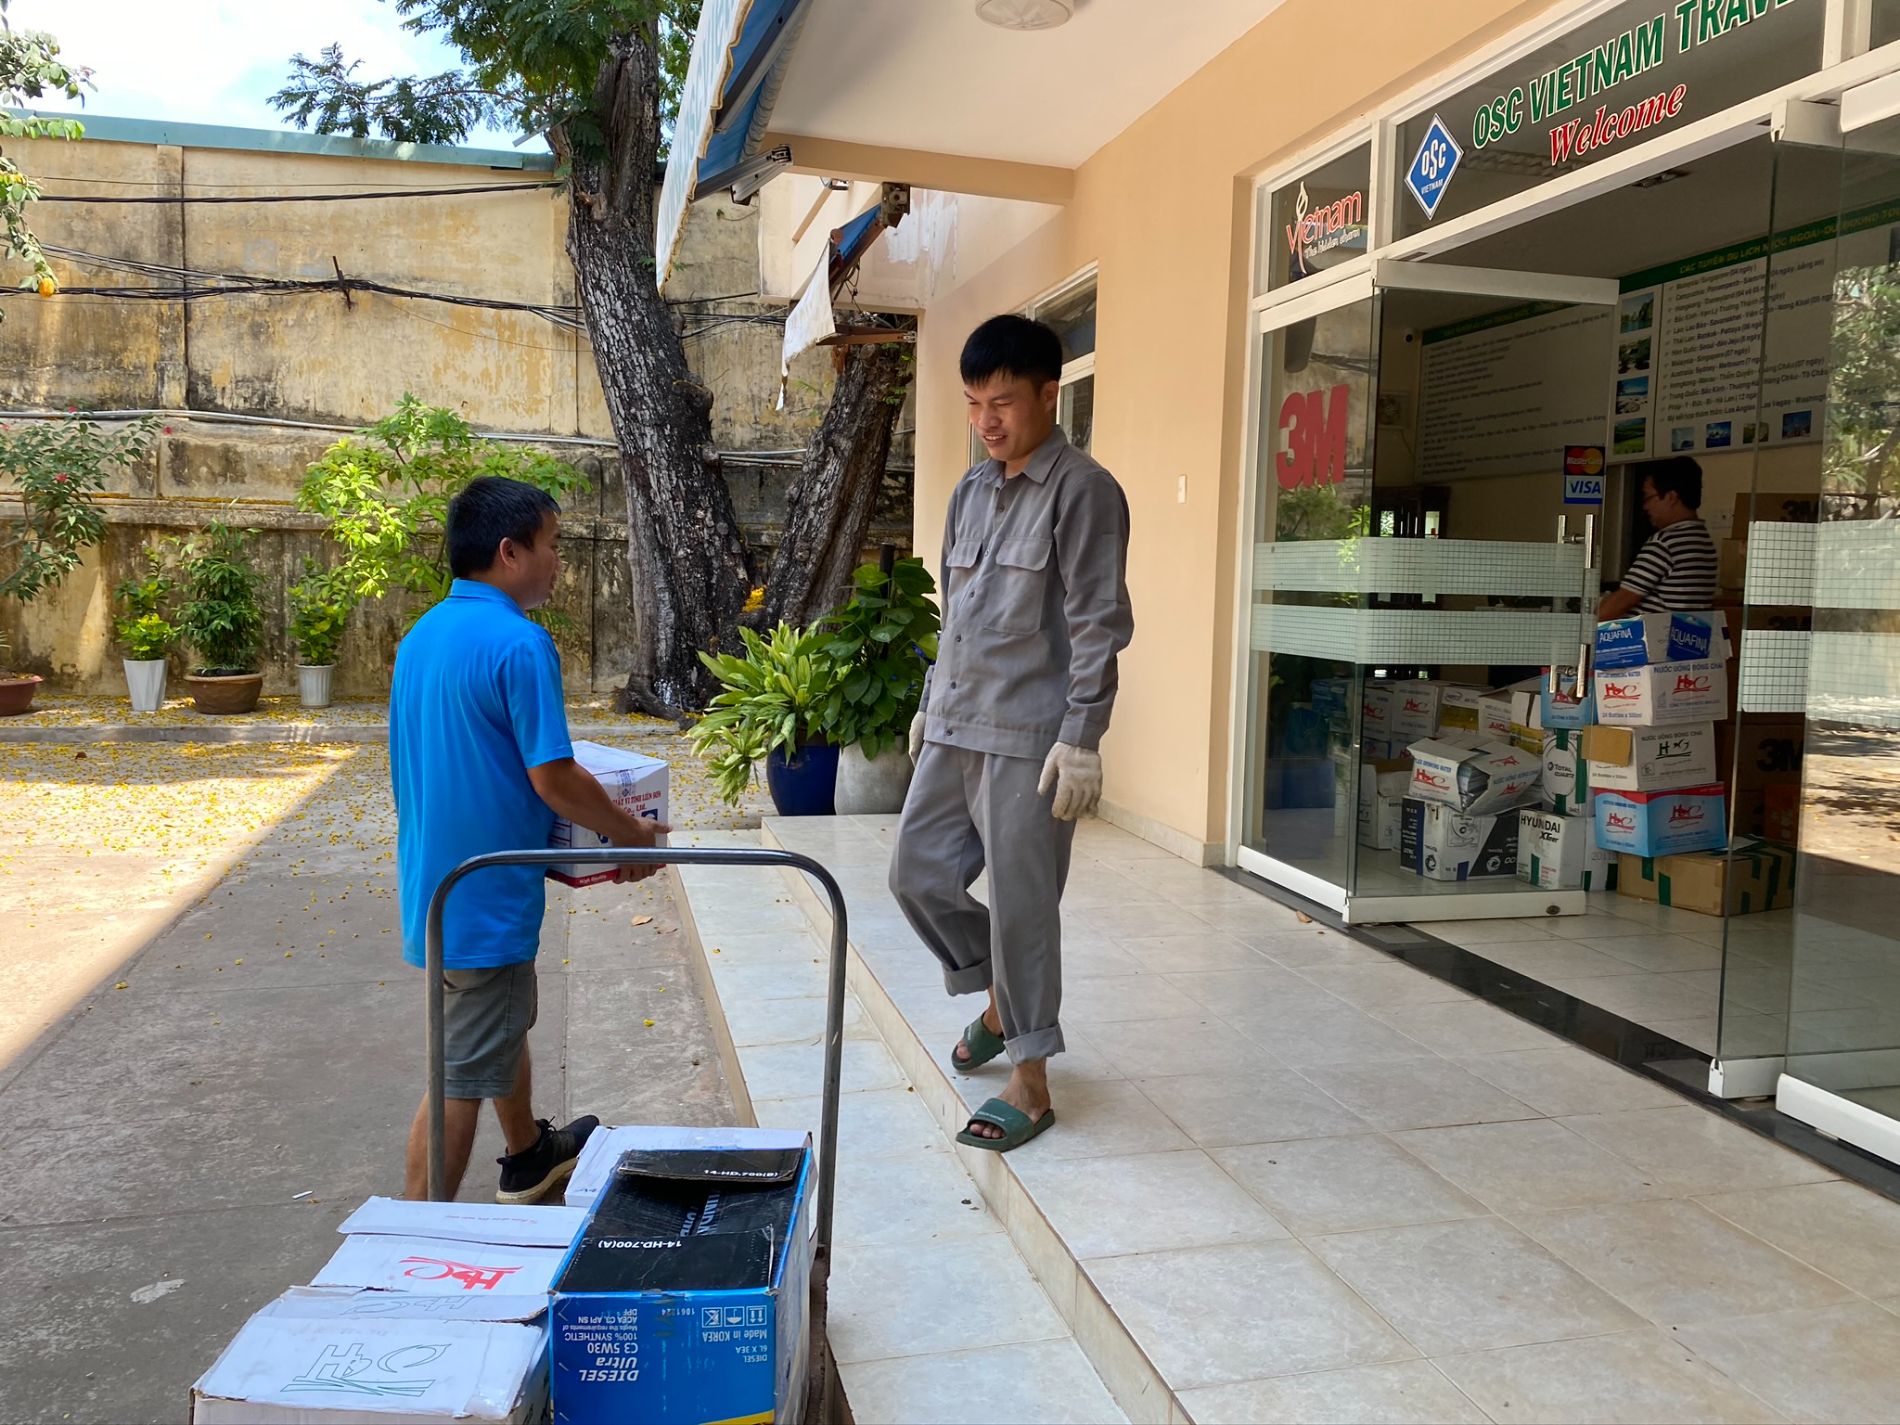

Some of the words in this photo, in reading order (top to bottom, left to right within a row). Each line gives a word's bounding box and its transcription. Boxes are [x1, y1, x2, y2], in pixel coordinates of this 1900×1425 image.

[1473, 87, 1523, 149] OSC
[1529, 13, 1666, 124] VIETNAM
[1674, 0, 1795, 54] TRA
[1549, 83, 1687, 166] Welcome
[1421, 138, 1447, 179] OSC
[1421, 178, 1443, 195] VIETNAM
[1275, 384, 1349, 489] 3M
[1570, 480, 1601, 494] VISA
[1599, 627, 1633, 643] AQUAFINA
[1670, 627, 1708, 650] AQUAFINA
[1520, 814, 1561, 833] HYUNDAI
[597, 1239, 682, 1249] 14-HD.700(A)
[564, 1332, 613, 1341] SYNTHETIC
[614, 1332, 638, 1341] 100%
[702, 1330, 730, 1342] KOREA
[733, 1329, 741, 1341] in
[744, 1328, 767, 1340] Made
[587, 1342, 620, 1354] 5W30
[624, 1342, 638, 1354] C3
[596, 1356, 638, 1369] Ultra
[742, 1354, 768, 1363] DIESEL
[578, 1369, 639, 1382] DIESEL
